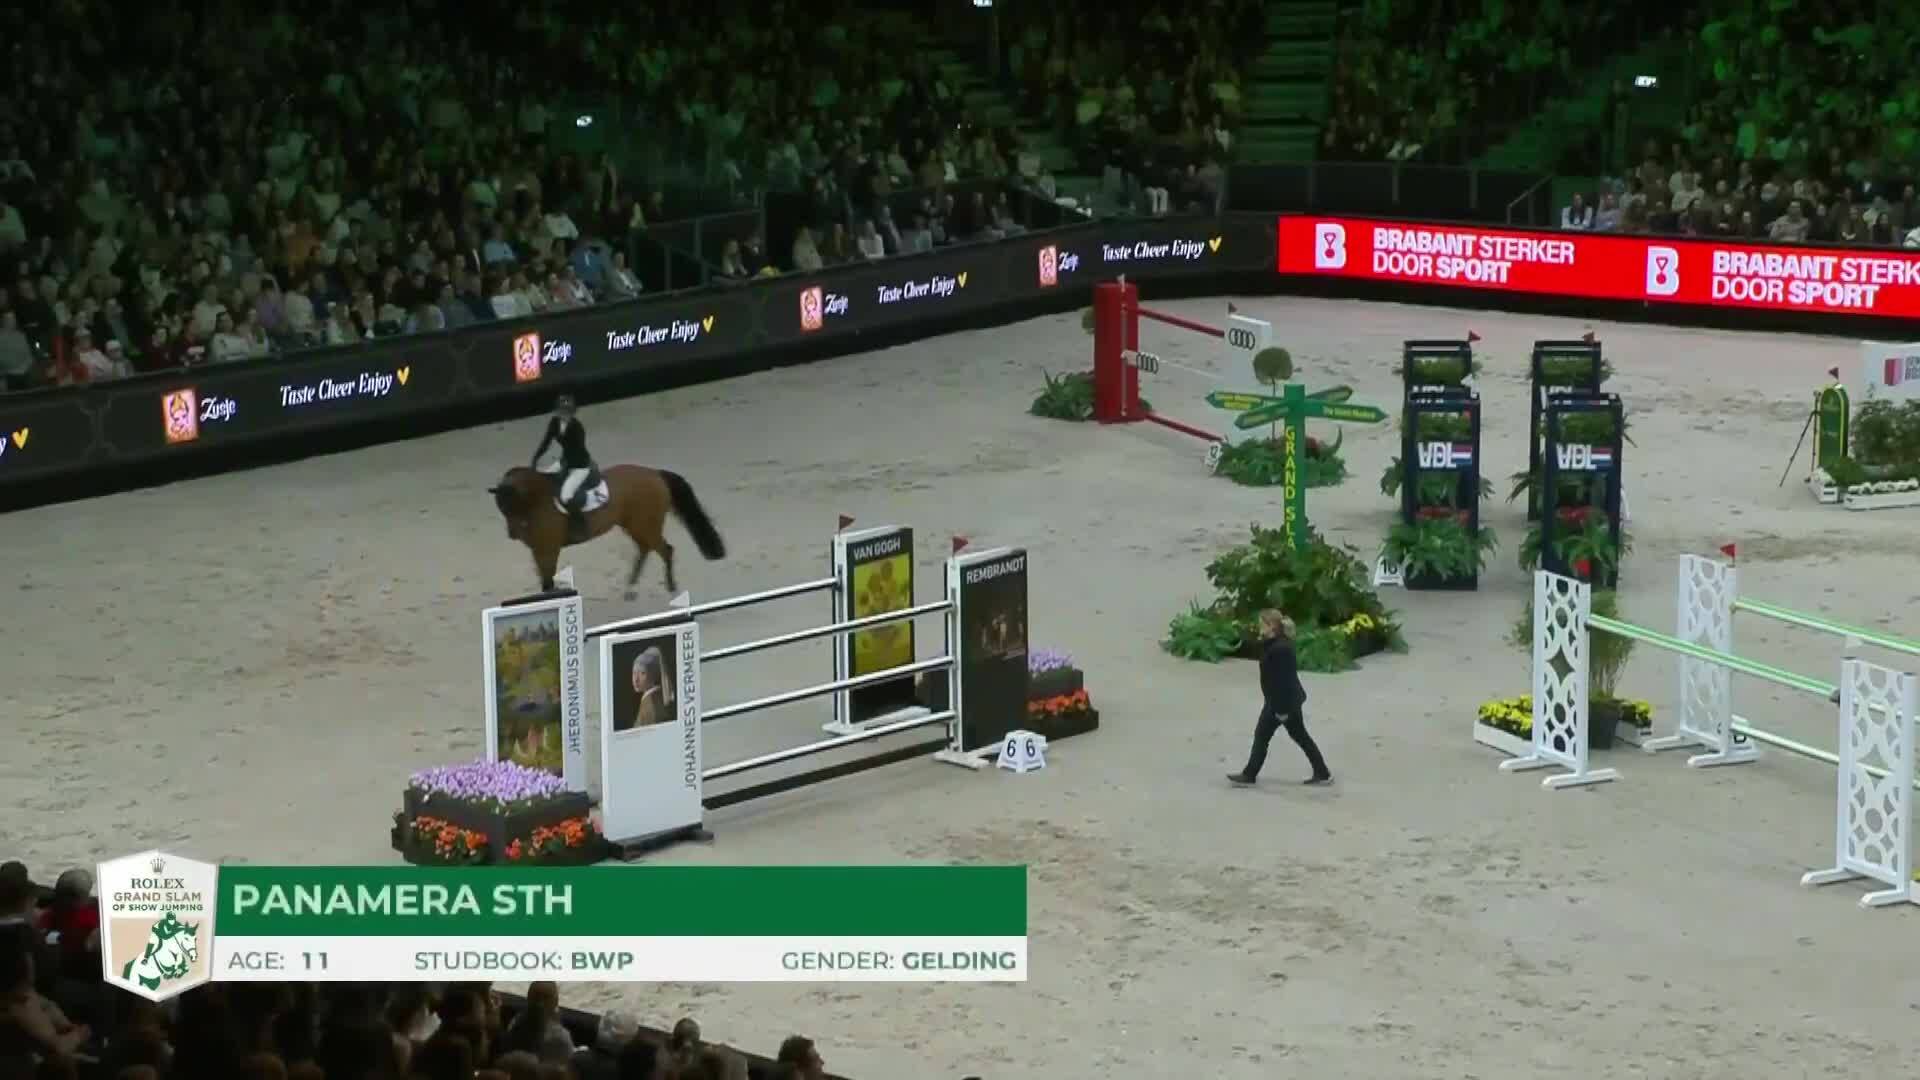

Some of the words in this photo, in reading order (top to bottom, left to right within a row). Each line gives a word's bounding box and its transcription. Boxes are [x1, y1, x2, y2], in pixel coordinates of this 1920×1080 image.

[1102, 244, 1132, 262] Taste
[1133, 241, 1169, 259] Cheer
[1172, 239, 1204, 259] Enjoy
[1373, 228, 1477, 257] BRABANT
[1478, 237, 1575, 265] STERKER
[1373, 250, 1433, 276] DOOR
[1436, 256, 1511, 284] SPORT
[1713, 250, 1838, 281] BRABANT
[1840, 258, 1920, 285] STERK
[878, 286, 902, 305] Taste
[904, 281, 929, 299] Cheer
[931, 275, 956, 297] Enjoy
[1712, 275, 1784, 302] DOOR
[1788, 280, 1880, 308] SPORT
[607, 330, 635, 351] Taste
[637, 325, 669, 345] Cheer
[671, 319, 700, 343] Enjoy
[279, 384, 316, 408] Taste
[318, 376, 356, 400] Cheer
[357, 371, 393, 398] Enjoy
[1285, 426, 1296, 500] GRAND
[1417, 441, 1457, 468] VDL
[1556, 443, 1597, 470] VDL
[1285, 506, 1296, 551] SLA
[854, 544, 873, 561] VAN
[875, 538, 901, 556] GOGH
[966, 557, 1025, 584] REMBRANDT
[565, 603, 578, 655] BOSCH
[682, 631, 694, 705] VERMEER
[567, 658, 582, 754] JHERONIMUS
[683, 709, 697, 789] JOHANNES
[1007, 739, 1017, 758] 6
[1026, 738, 1036, 758] 6
